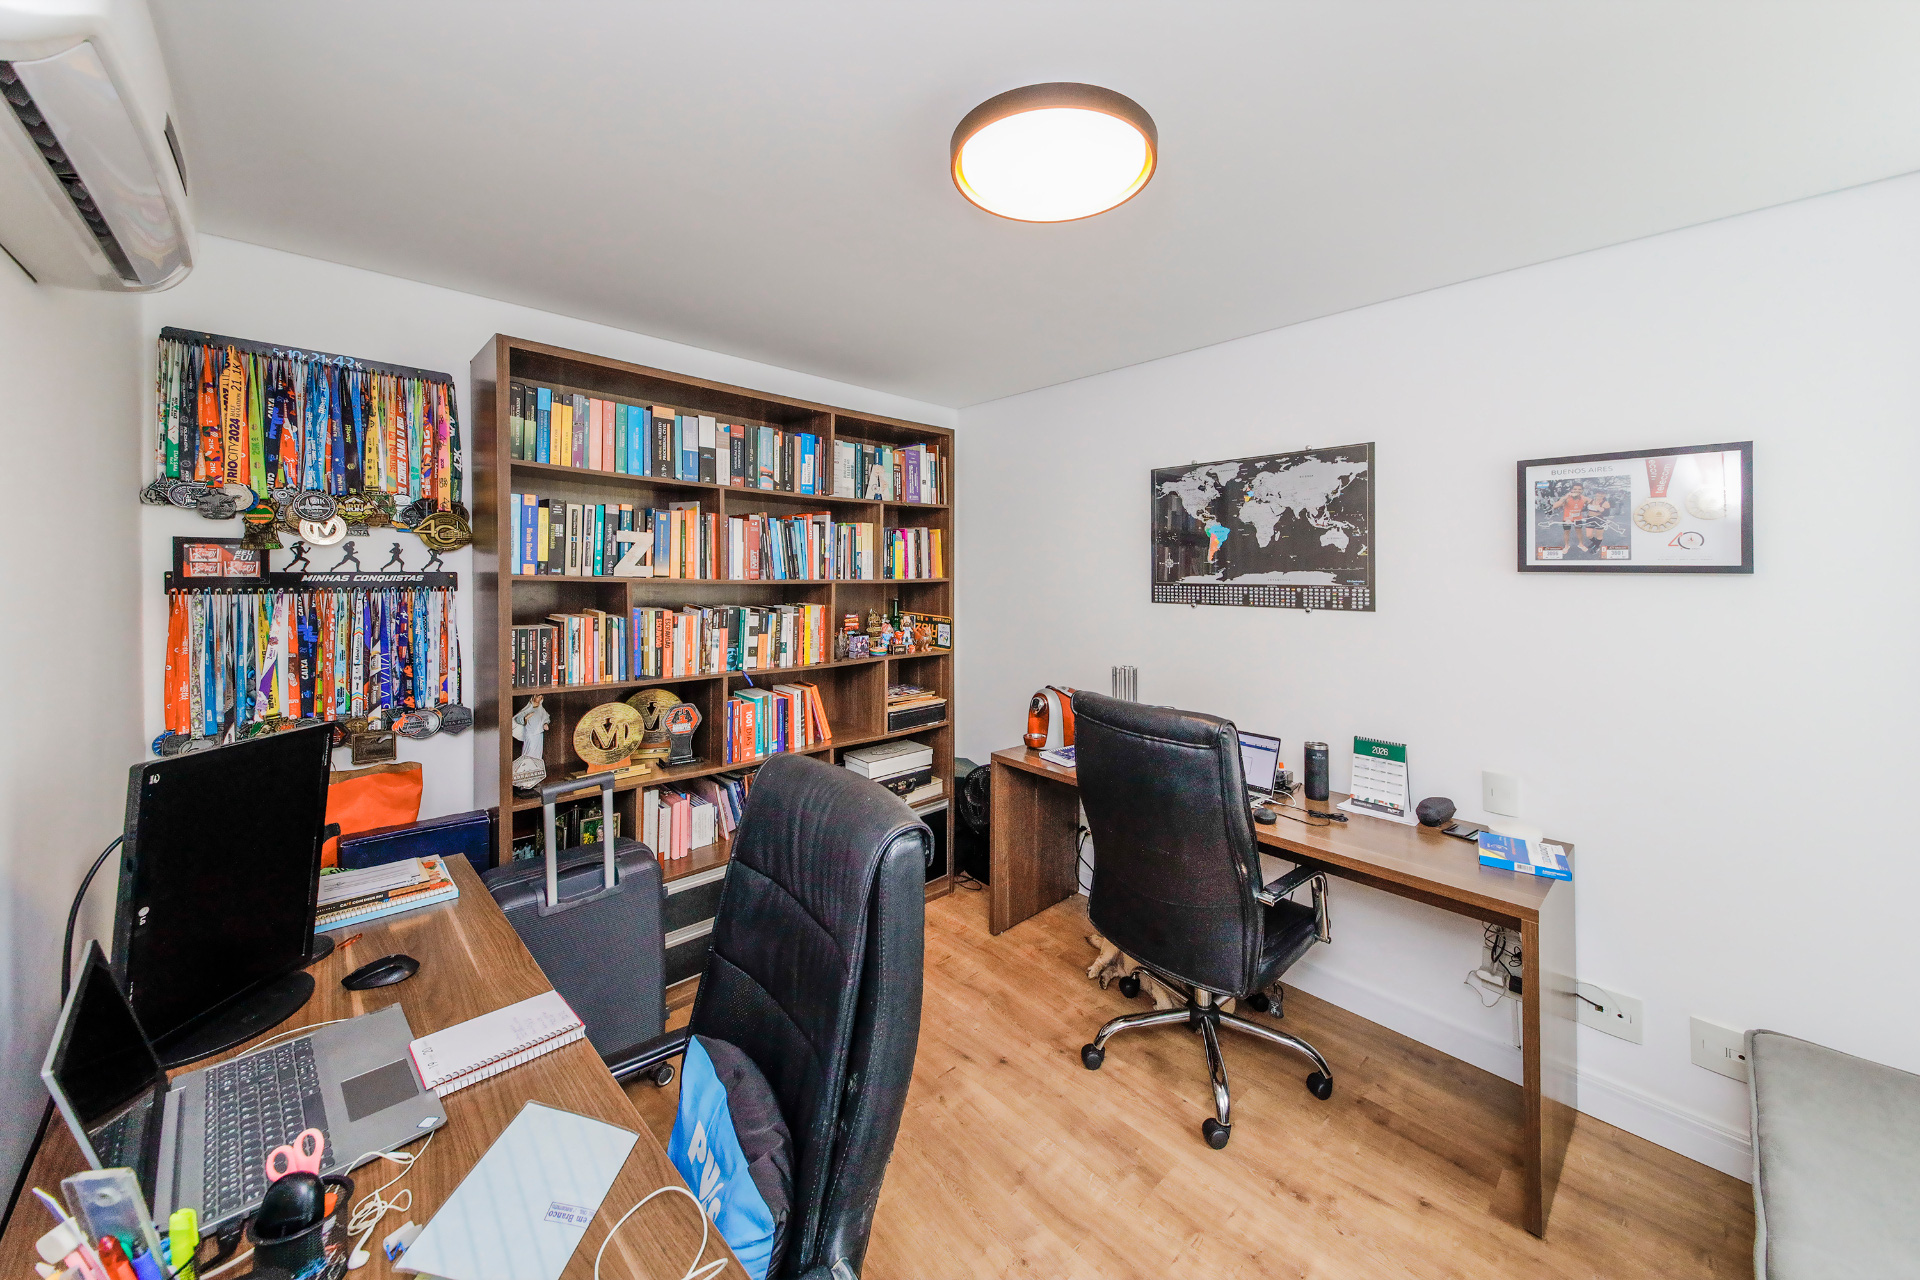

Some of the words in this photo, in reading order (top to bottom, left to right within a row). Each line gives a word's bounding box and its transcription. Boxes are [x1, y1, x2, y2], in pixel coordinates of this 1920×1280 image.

[312, 352, 332, 364] 21K
[333, 355, 363, 369] 42K
[230, 364, 242, 392] 21.1K
[397, 437, 406, 460] PARA
[452, 448, 462, 473] 42K
[1551, 467, 1587, 476] BUENOS
[1588, 465, 1614, 473] AIRES
[1655, 463, 1672, 494] telecom
[614, 530, 654, 577] Z
[301, 574, 350, 582] MINHAS
[353, 574, 424, 583] CONQUISTAS
[301, 658, 309, 680] CAIXA
[745, 710, 753, 728] 1001
[745, 728, 753, 746] DIAS
[1372, 745, 1389, 756] 2026
[547, 1208, 575, 1223] Branco
